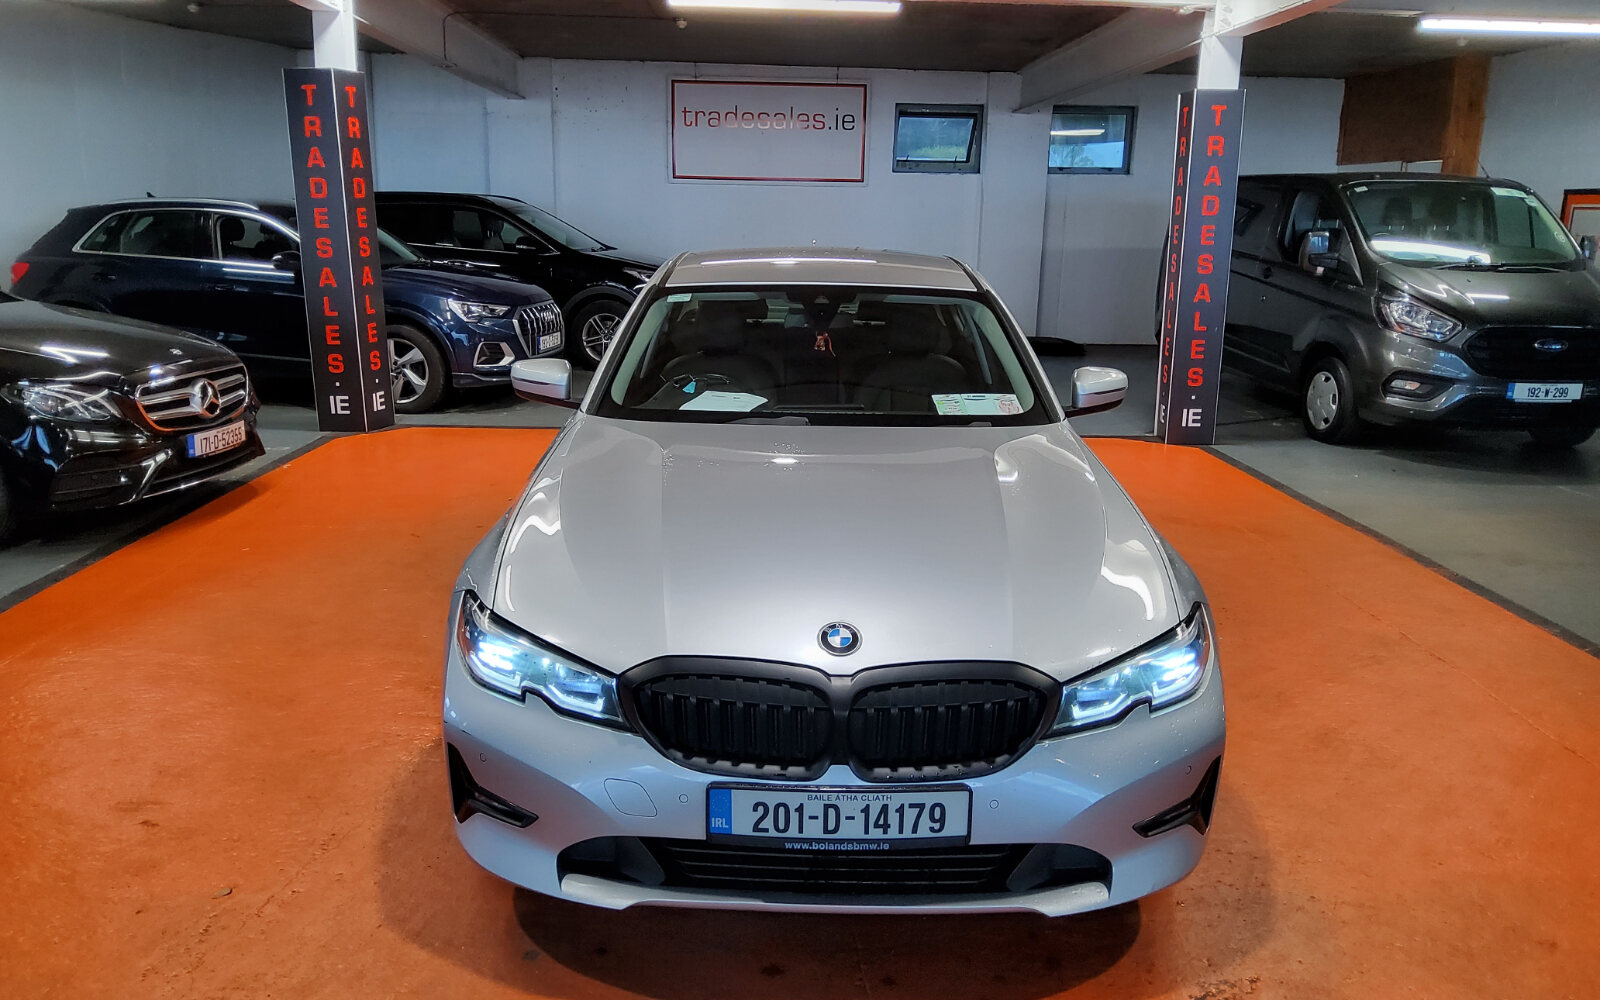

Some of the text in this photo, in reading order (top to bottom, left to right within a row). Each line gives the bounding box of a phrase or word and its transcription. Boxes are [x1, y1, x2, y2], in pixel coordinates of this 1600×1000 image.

[681, 105, 856, 131] tradesales.ie
[1527, 387, 1569, 398] 192-W-299
[200, 427, 242, 453] 171-D-52355
[835, 793, 859, 801] ÁTHA
[711, 817, 729, 828] IRL
[752, 801, 947, 835] 201-D-14179
[784, 841, 890, 851] www.bolandsbmw.ie
